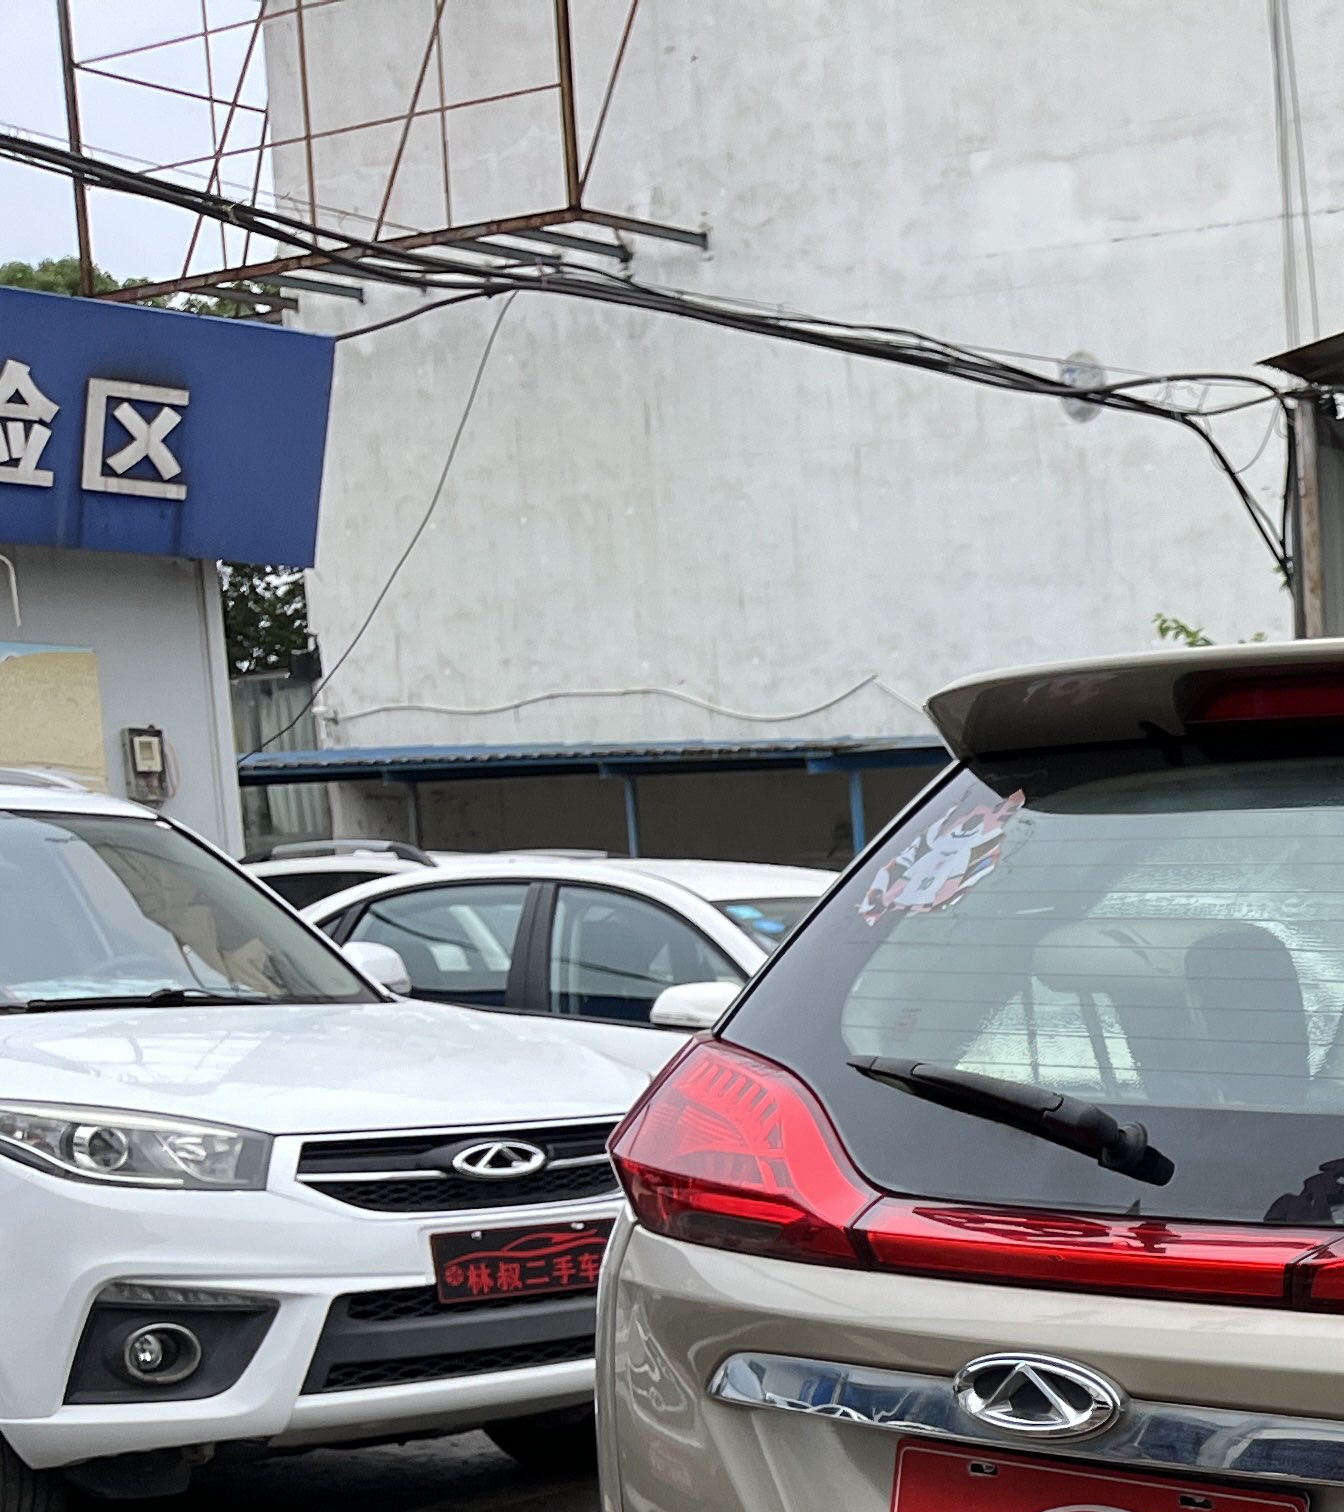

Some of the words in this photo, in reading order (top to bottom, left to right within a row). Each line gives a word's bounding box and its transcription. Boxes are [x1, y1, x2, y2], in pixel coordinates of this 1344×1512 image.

[467, 1252, 600, 1296] 林叔二手车
